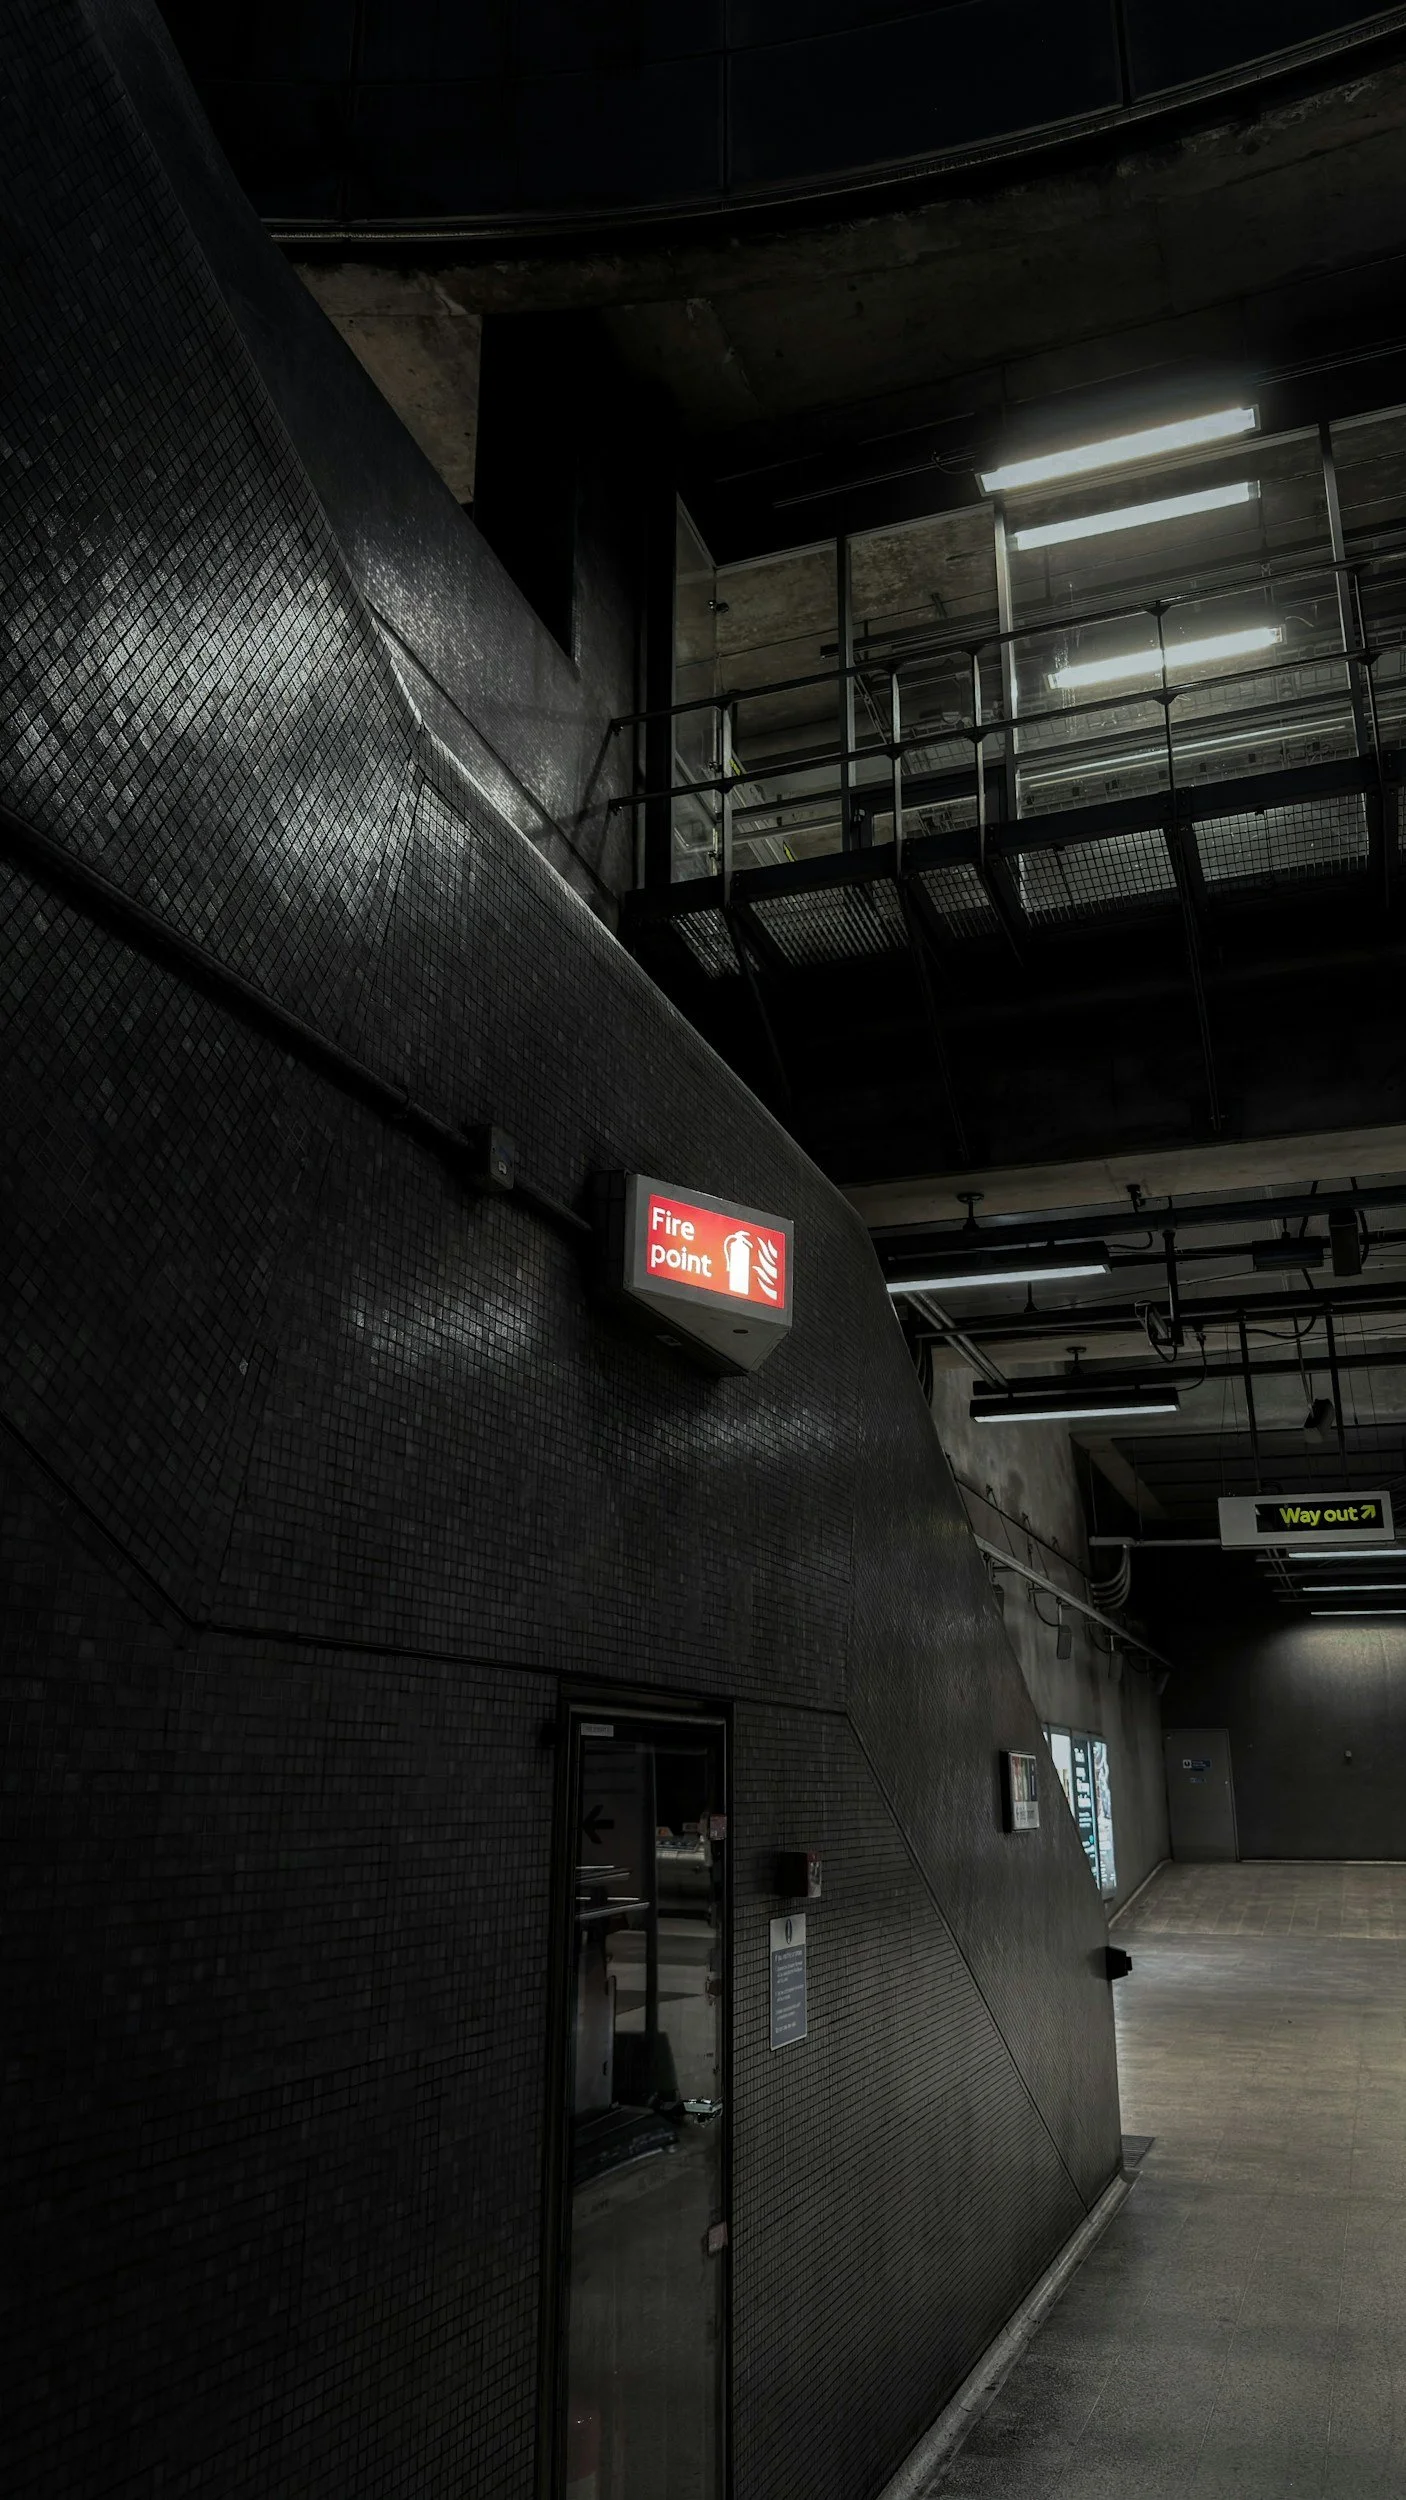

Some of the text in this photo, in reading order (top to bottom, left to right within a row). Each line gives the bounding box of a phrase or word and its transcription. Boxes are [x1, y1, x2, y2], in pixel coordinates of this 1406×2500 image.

[652, 1207, 695, 1241] Fire
[651, 1244, 712, 1277] point
[1279, 1506, 1359, 1526] Way out
